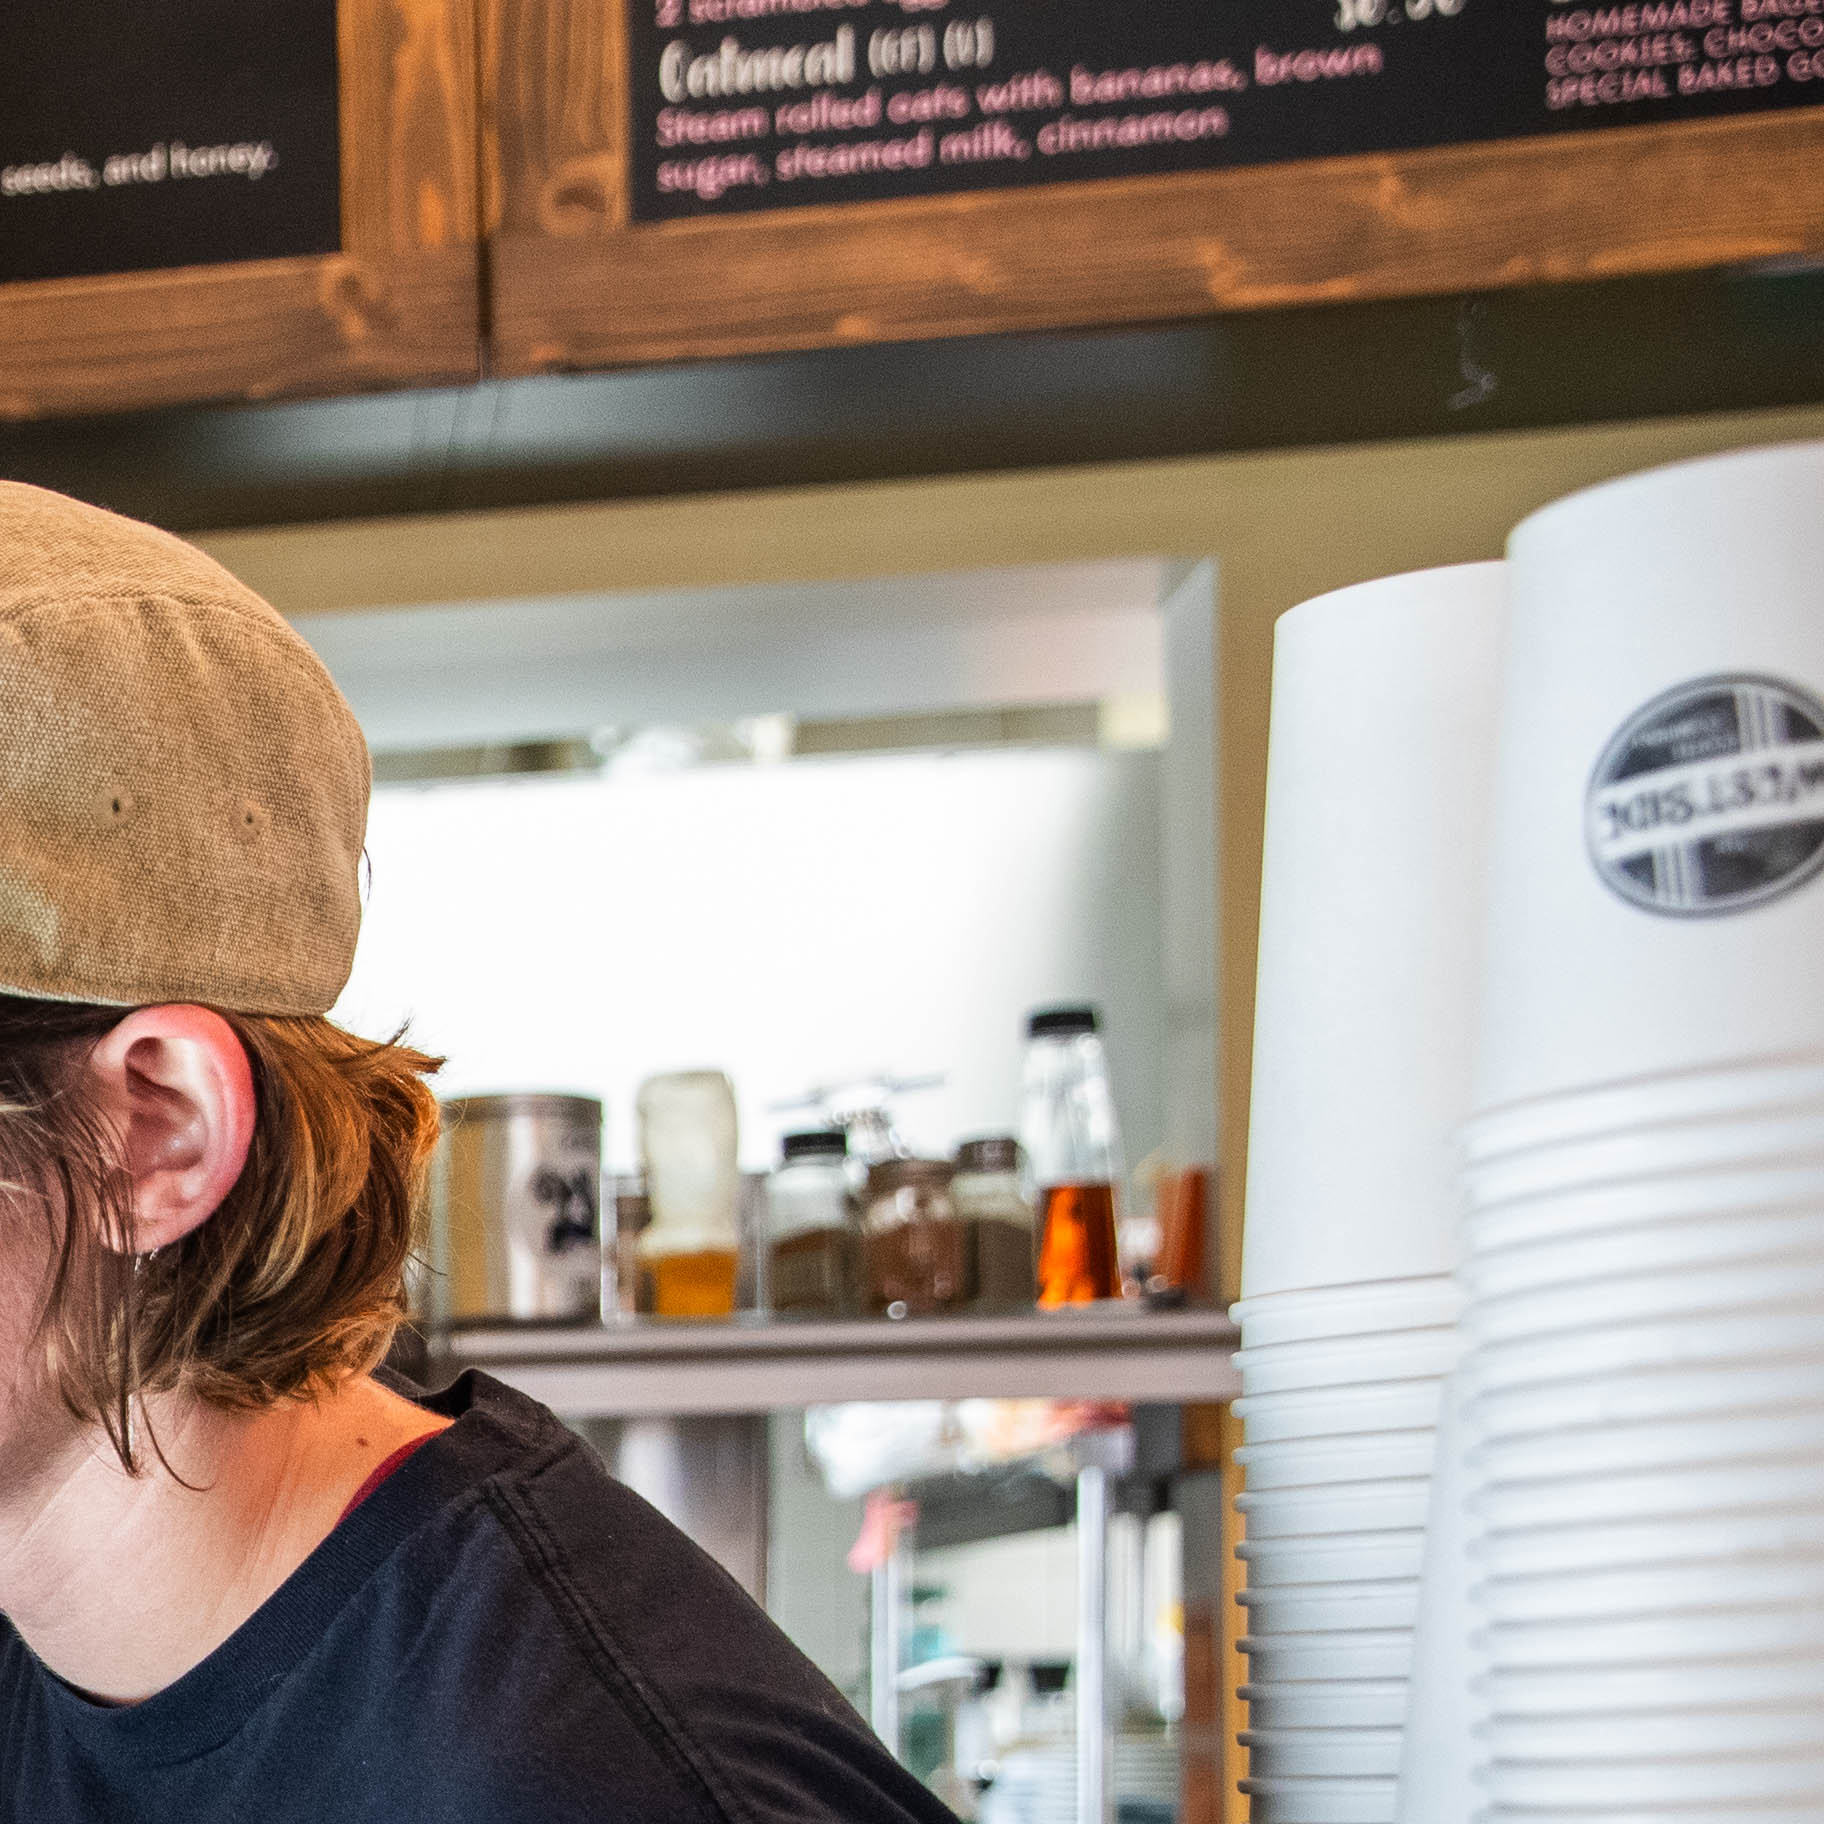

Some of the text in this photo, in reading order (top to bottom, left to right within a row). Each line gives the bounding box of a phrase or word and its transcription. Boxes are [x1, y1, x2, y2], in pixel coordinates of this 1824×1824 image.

[659, 22, 855, 103] Oatmeal
[774, 87, 884, 136] rolled
[886, 82, 971, 125] oats
[976, 68, 1065, 115] with
[1254, 41, 1384, 87] brown
[101, 141, 169, 187] and
[774, 126, 935, 181] steamed
[1036, 105, 1229, 156] cinnamon
